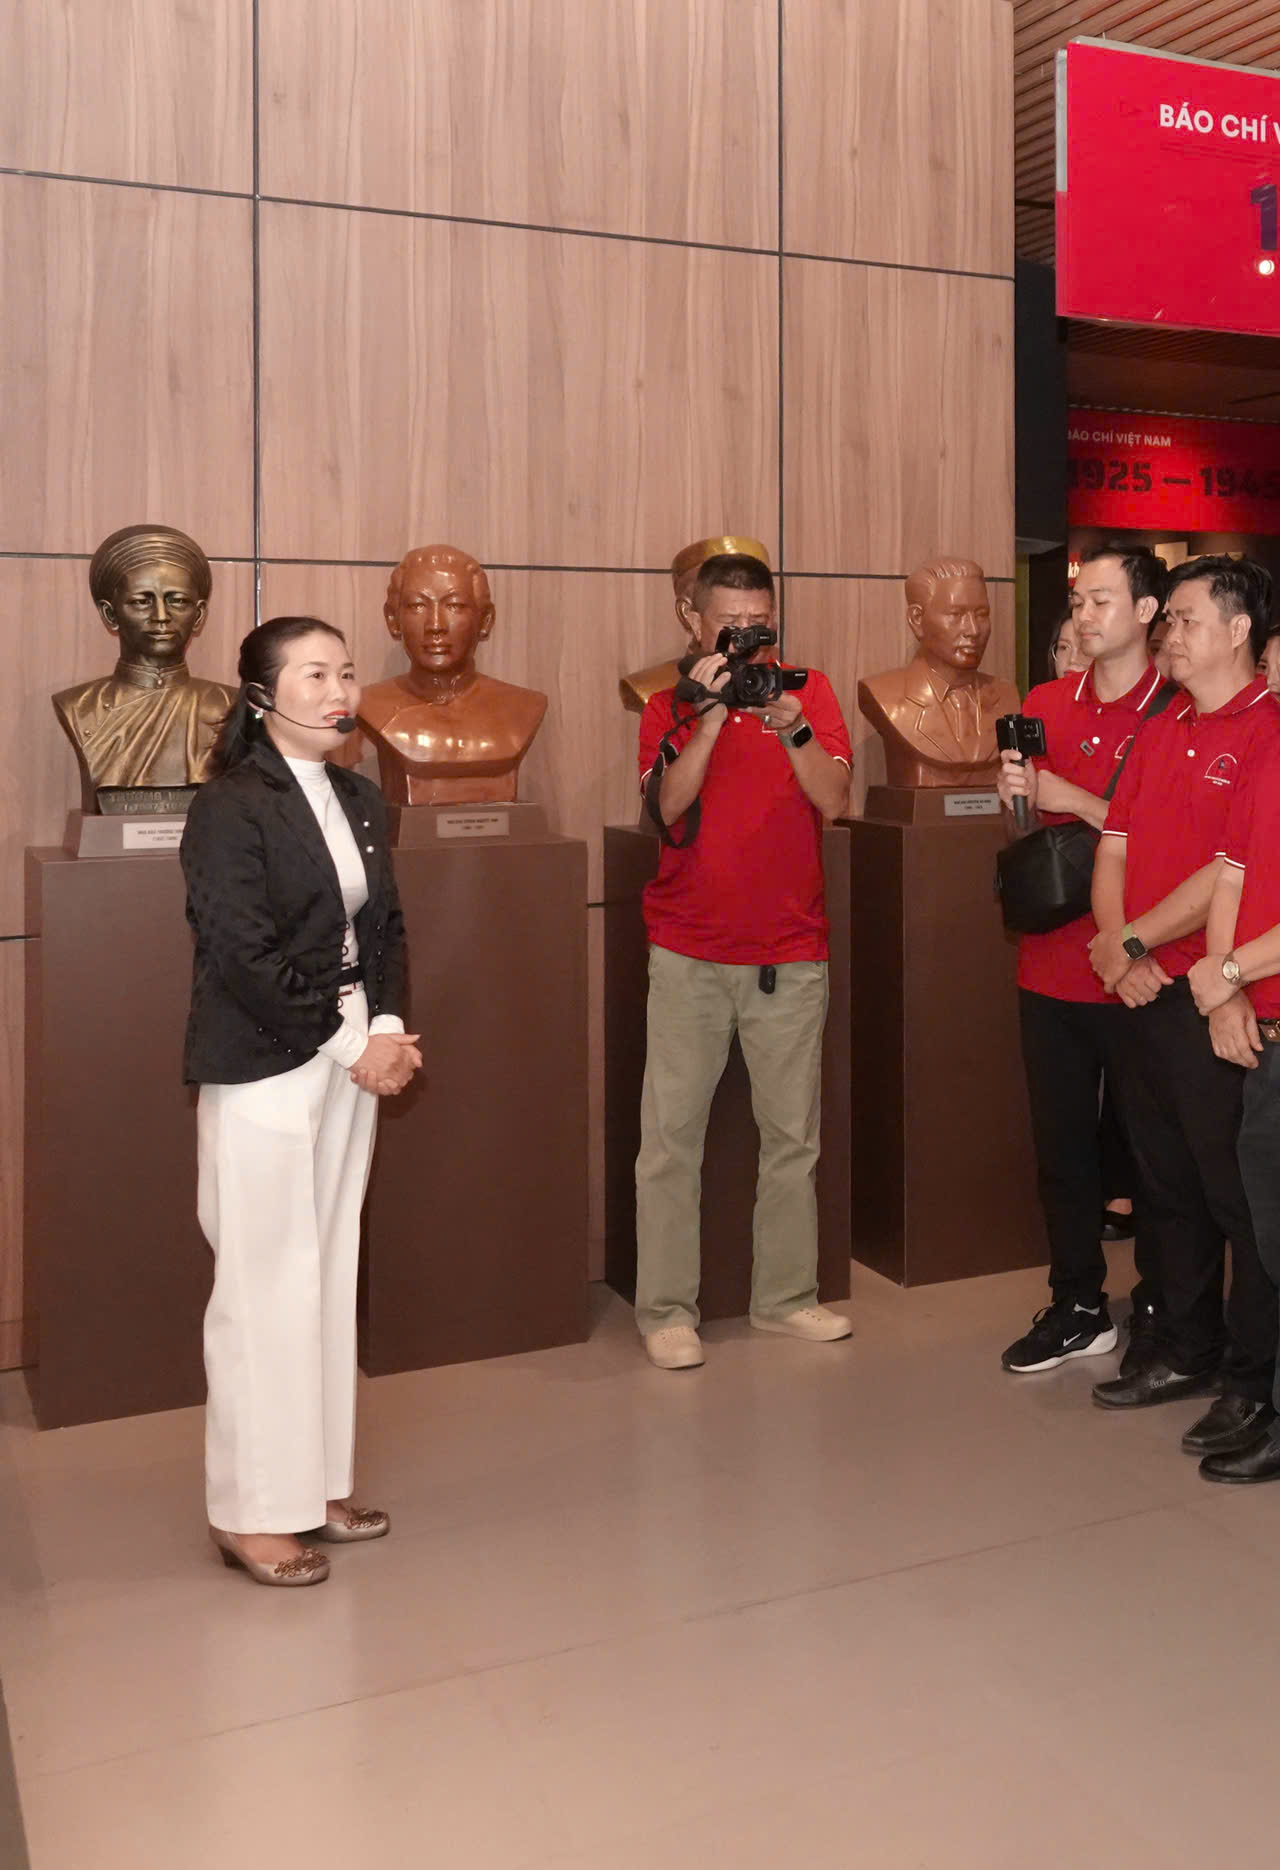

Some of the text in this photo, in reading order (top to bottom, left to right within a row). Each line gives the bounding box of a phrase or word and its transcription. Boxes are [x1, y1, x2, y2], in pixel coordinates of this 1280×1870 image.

[1159, 103, 1213, 136] BÁO
[1220, 110, 1267, 143] CHÍ
[1092, 429, 1114, 443] CHÍ
[1116, 432, 1142, 448] VIỆT
[1144, 434, 1172, 447] NAM
